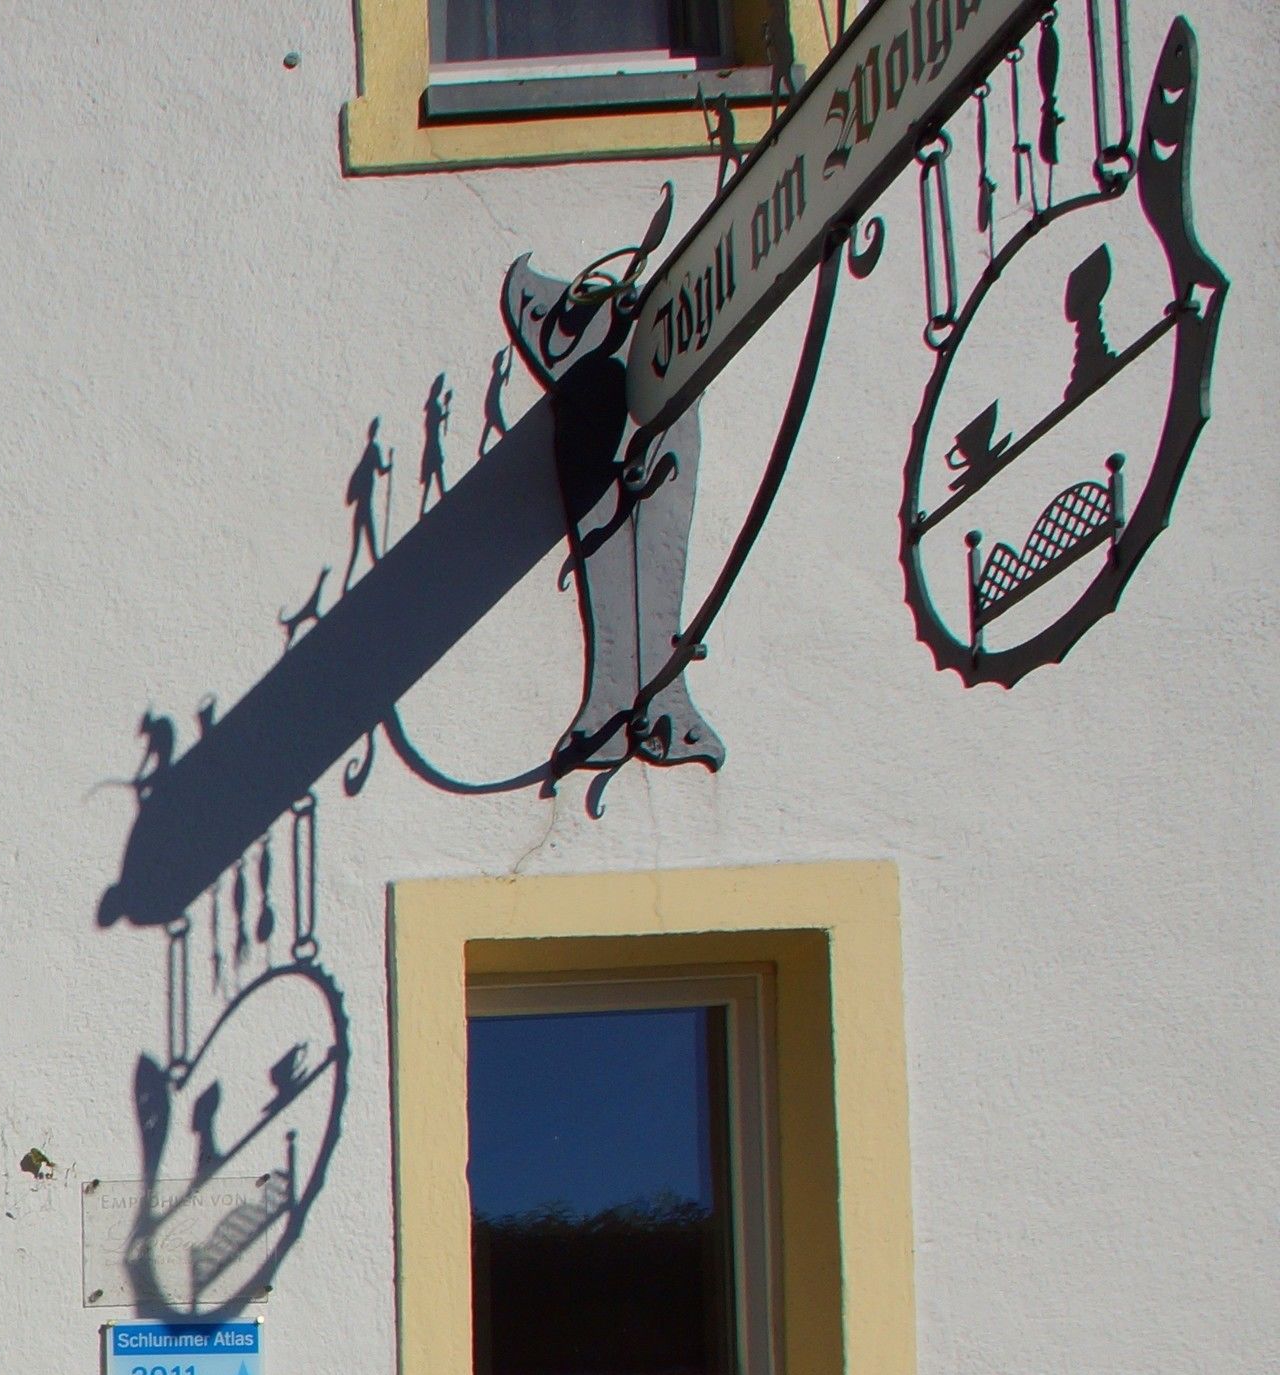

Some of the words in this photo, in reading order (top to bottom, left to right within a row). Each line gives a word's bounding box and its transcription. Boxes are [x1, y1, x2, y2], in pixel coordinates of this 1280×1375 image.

[751, 154, 806, 272] am
[823, 0, 982, 181] Wolg
[117, 1332, 210, 1348] Schlummer
[213, 1330, 254, 1346] Atlas
